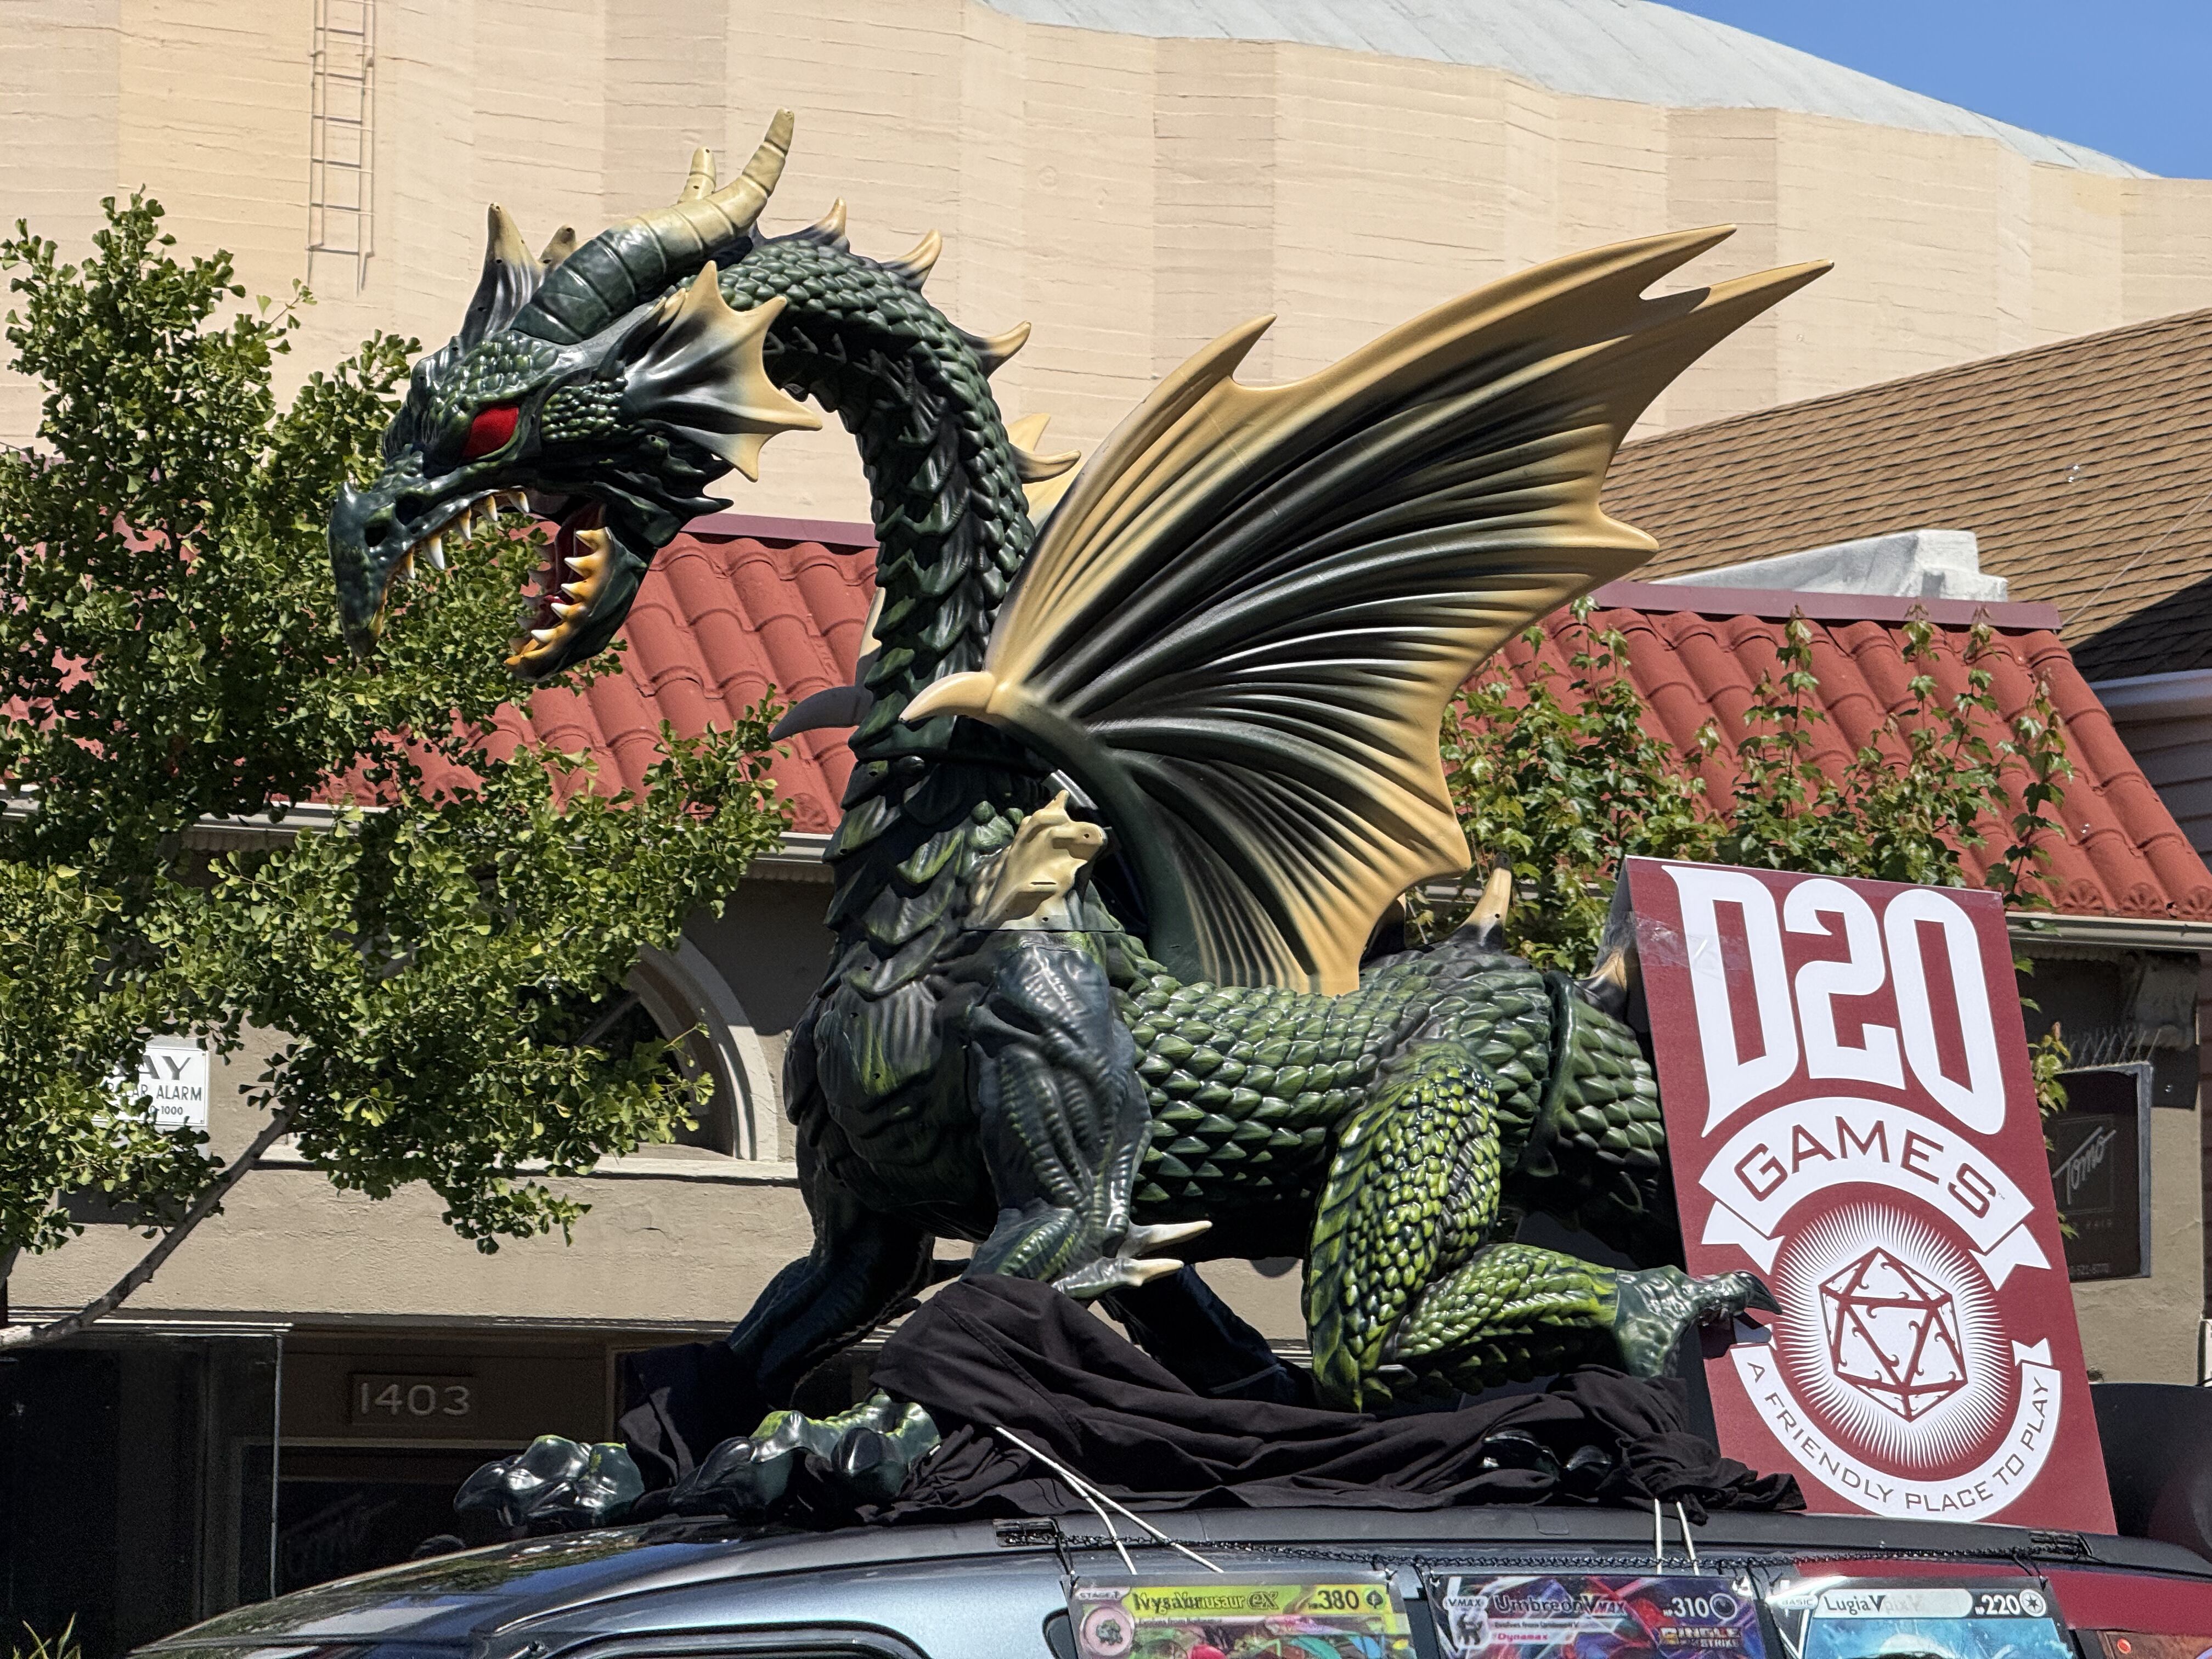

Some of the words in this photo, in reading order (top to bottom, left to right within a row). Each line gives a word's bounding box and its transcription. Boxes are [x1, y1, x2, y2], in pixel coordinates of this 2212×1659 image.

[138, 1054, 191, 1081] AY
[156, 1085, 202, 1101] ALARM
[1734, 1115, 1996, 1218] GAMES
[360, 1382, 470, 1416] 1403
[1747, 1362, 1765, 1383] A
[1764, 1392, 1894, 1503] FRIENDLY
[1905, 1480, 1994, 1512] PLACE
[1991, 1453, 2025, 1486] TO
[2020, 1375, 2049, 1452] PLAY
[1317, 1589, 1359, 1610] 380
[1448, 1598, 1481, 1607] VMAX
[1672, 1596, 1709, 1618] 310
[1981, 1594, 2021, 1615] 220
[1497, 1633, 1548, 1642] Dynamax
